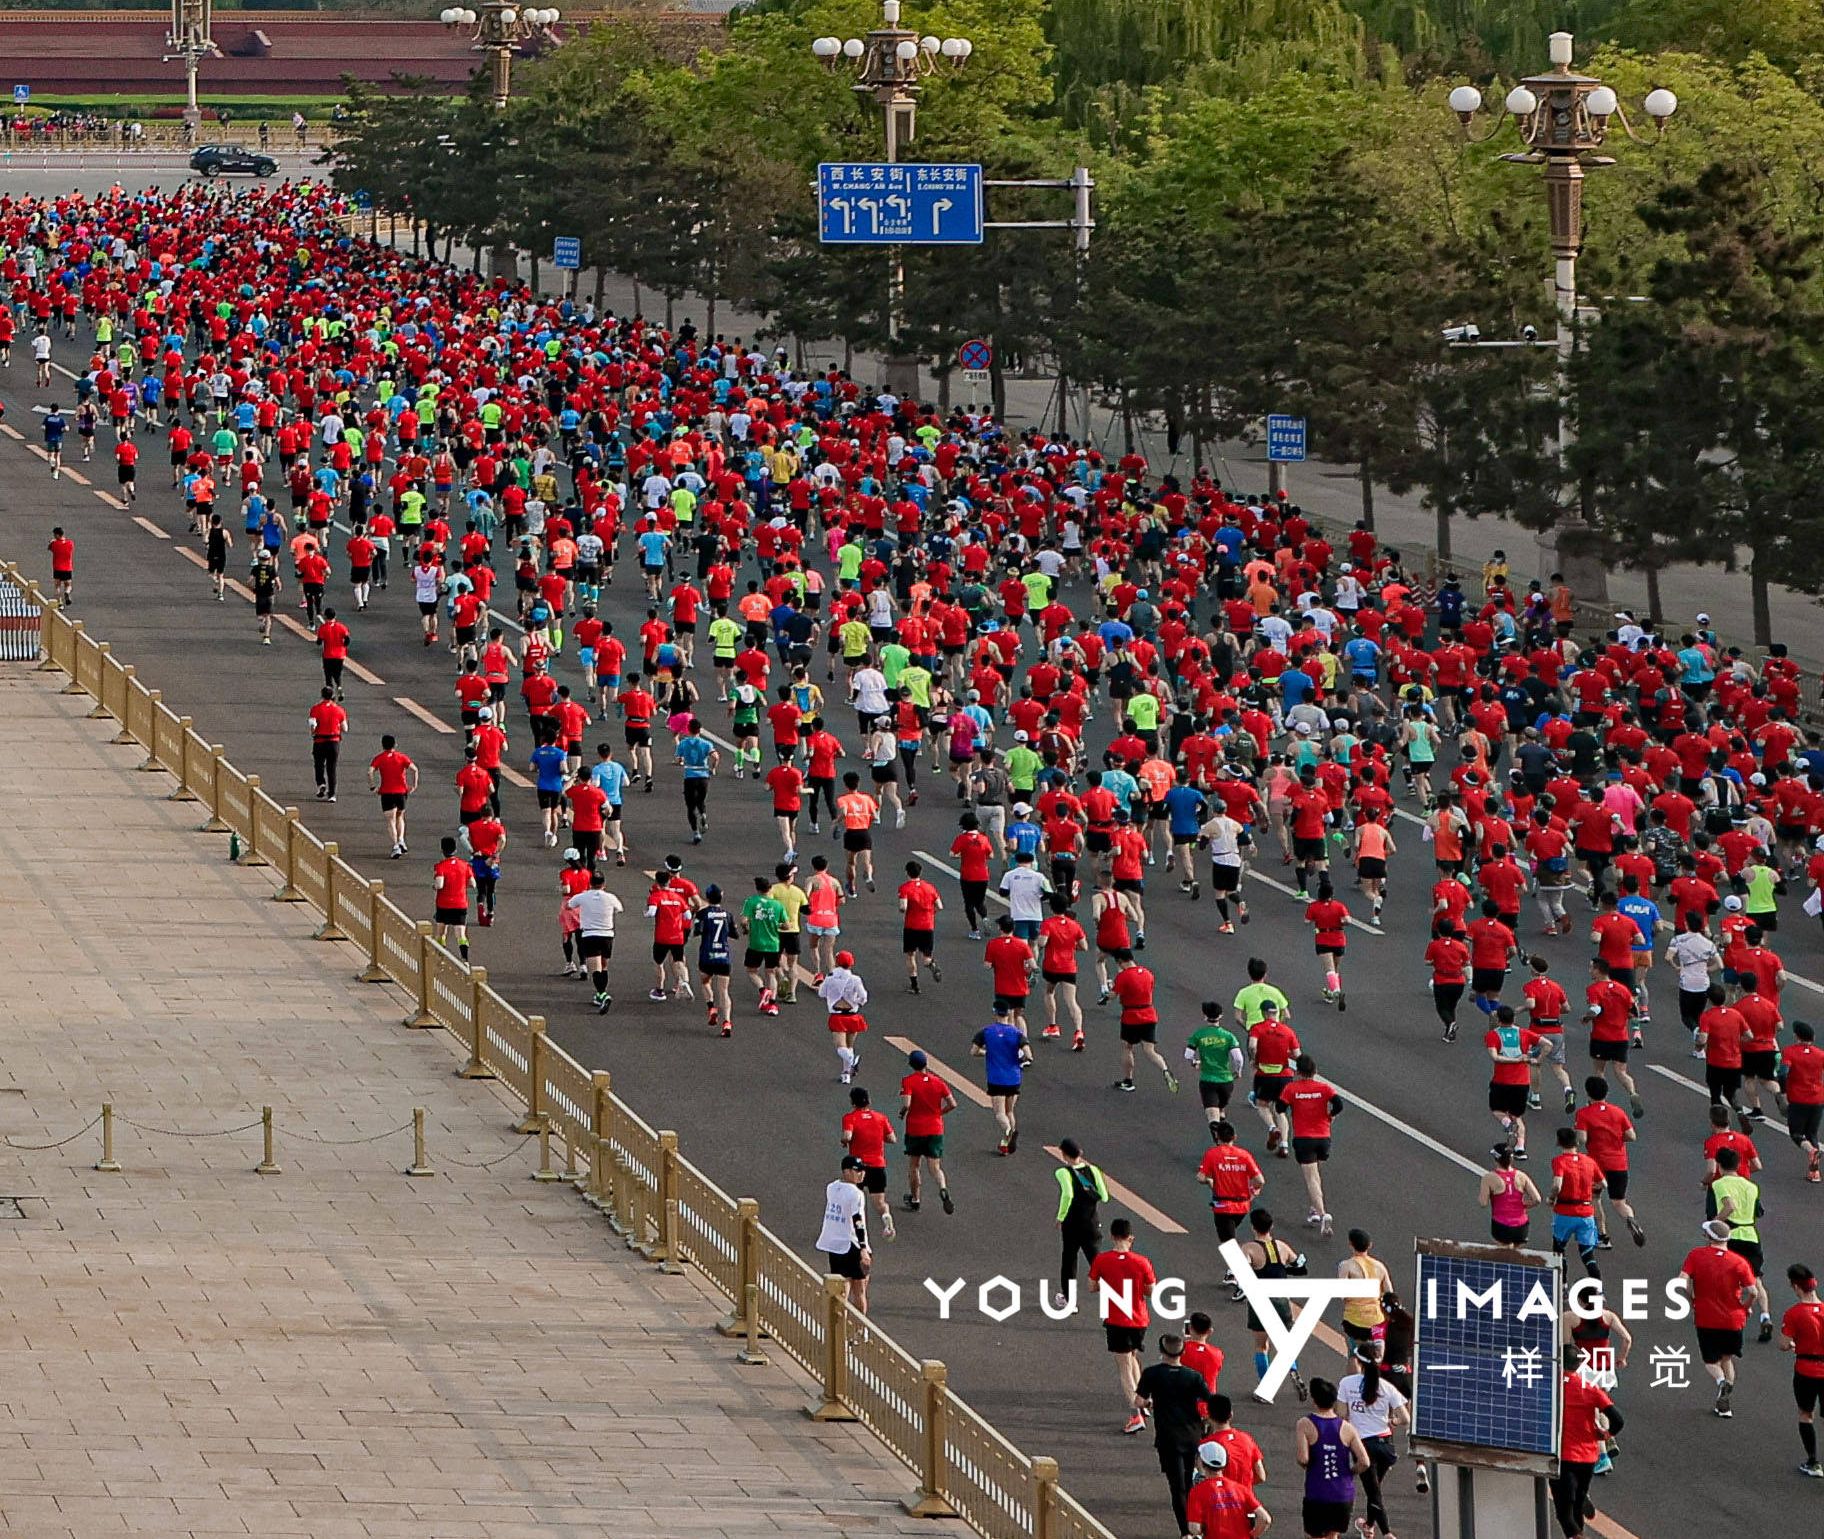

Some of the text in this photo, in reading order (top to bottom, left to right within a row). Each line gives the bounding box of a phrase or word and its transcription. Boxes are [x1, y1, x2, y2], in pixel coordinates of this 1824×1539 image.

[830, 167, 903, 181] 西长安街
[917, 167, 967, 182] 东长安街
[713, 919, 724, 942] 7
